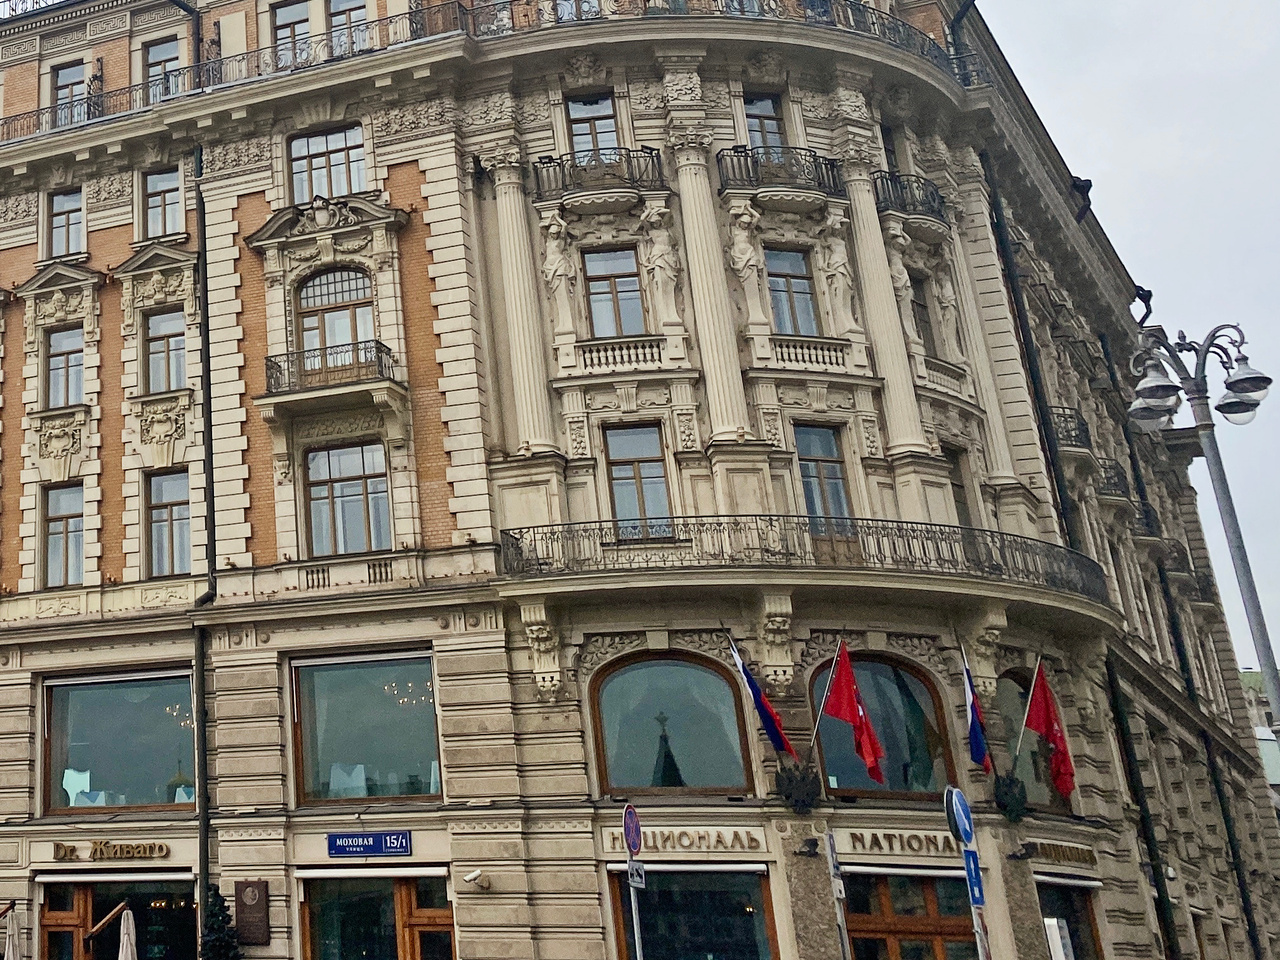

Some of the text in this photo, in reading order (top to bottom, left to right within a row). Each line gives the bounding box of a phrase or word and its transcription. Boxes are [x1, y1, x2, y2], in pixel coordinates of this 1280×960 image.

[336, 837, 374, 847] МОХОВАЯ
[385, 834, 406, 848] 15/1
[609, 830, 760, 852] НЦИОНАЛЬ
[53, 840, 170, 860] Dr. Живаго
